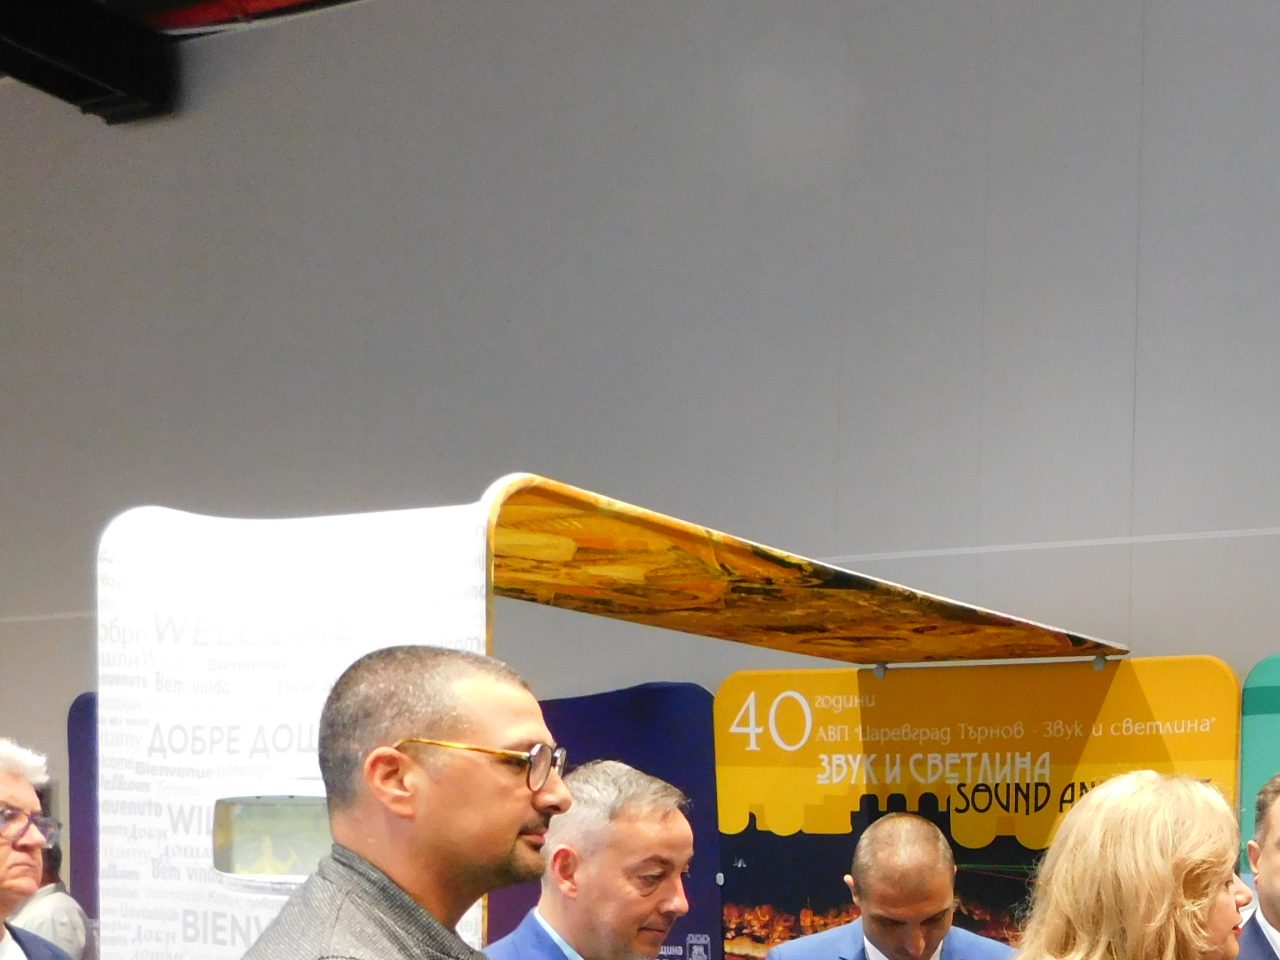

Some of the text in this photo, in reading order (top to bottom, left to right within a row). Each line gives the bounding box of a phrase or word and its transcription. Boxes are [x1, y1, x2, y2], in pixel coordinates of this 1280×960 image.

[729, 690, 876, 752] 40 години
[957, 720, 1026, 745] Търнов
[147, 722, 242, 760] ДОБРЕ
[816, 750, 1051, 786] ЗВУК И СВЕТЛИНА
[954, 781, 1051, 816] SOUND
